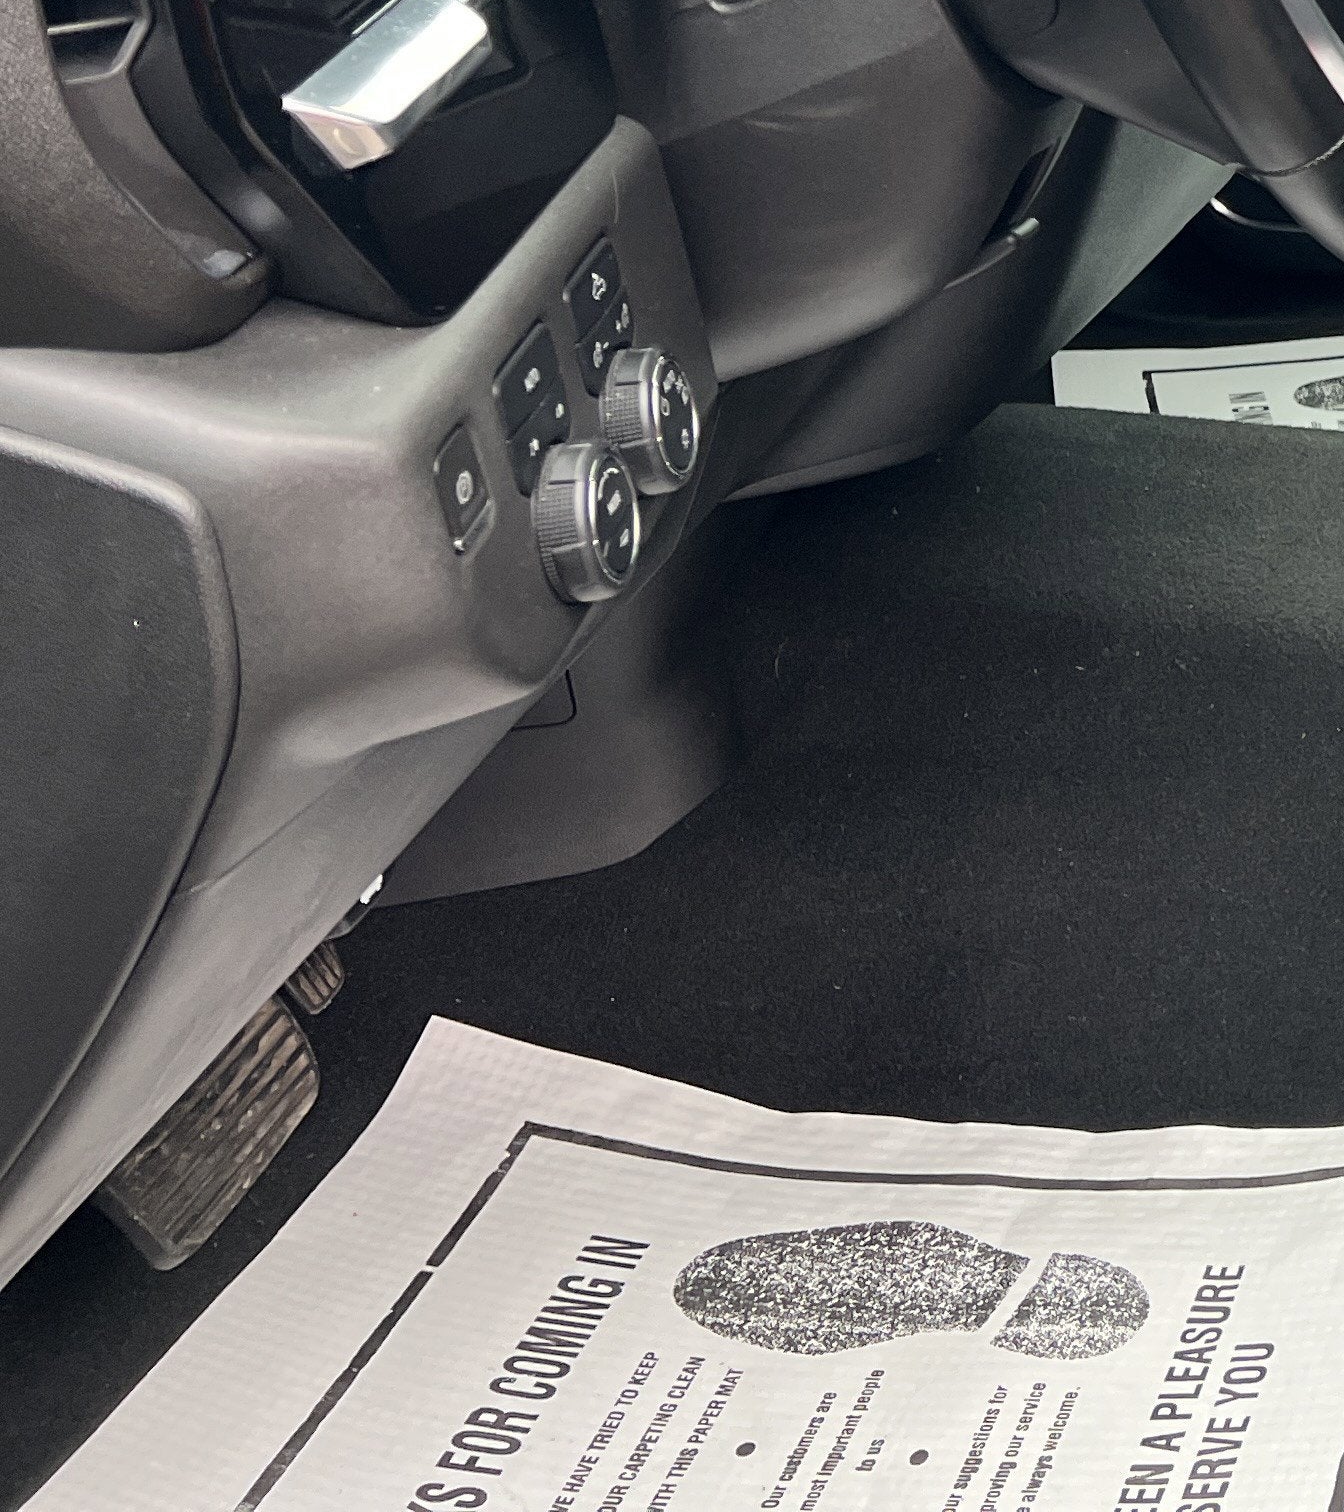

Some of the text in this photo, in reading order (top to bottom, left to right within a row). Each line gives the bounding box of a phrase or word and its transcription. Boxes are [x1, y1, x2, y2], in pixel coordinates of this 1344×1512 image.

[435, 1407, 540, 1476] FOR
[489, 1274, 626, 1400] COMING
[576, 1235, 651, 1270] IN
[1150, 1264, 1246, 1420] PLEASURE
[1214, 1342, 1275, 1407] YOU
[562, 1455, 600, 1494] HAVE
[586, 1410, 625, 1452] TRIED
[615, 1388, 640, 1407] TO
[628, 1351, 660, 1387] KEEP
[619, 1403, 678, 1481] CARPETING
[667, 1356, 706, 1400] CLEAN
[665, 1447, 700, 1479] THIS
[687, 1399, 726, 1445] PAPER
[715, 1368, 745, 1398] MAT
[761, 1392, 838, 1508] Our customers are
[800, 1369, 885, 1512] most important people
[855, 1439, 885, 1472] to us
[953, 1408, 1000, 1490] suggestions
[988, 1385, 1008, 1404] for
[1003, 1434, 1025, 1459] our
[1015, 1382, 1047, 1431] service
[1022, 1455, 1053, 1502] always
[1043, 1385, 1082, 1451] welcome.
[1139, 1431, 1186, 1452] A
